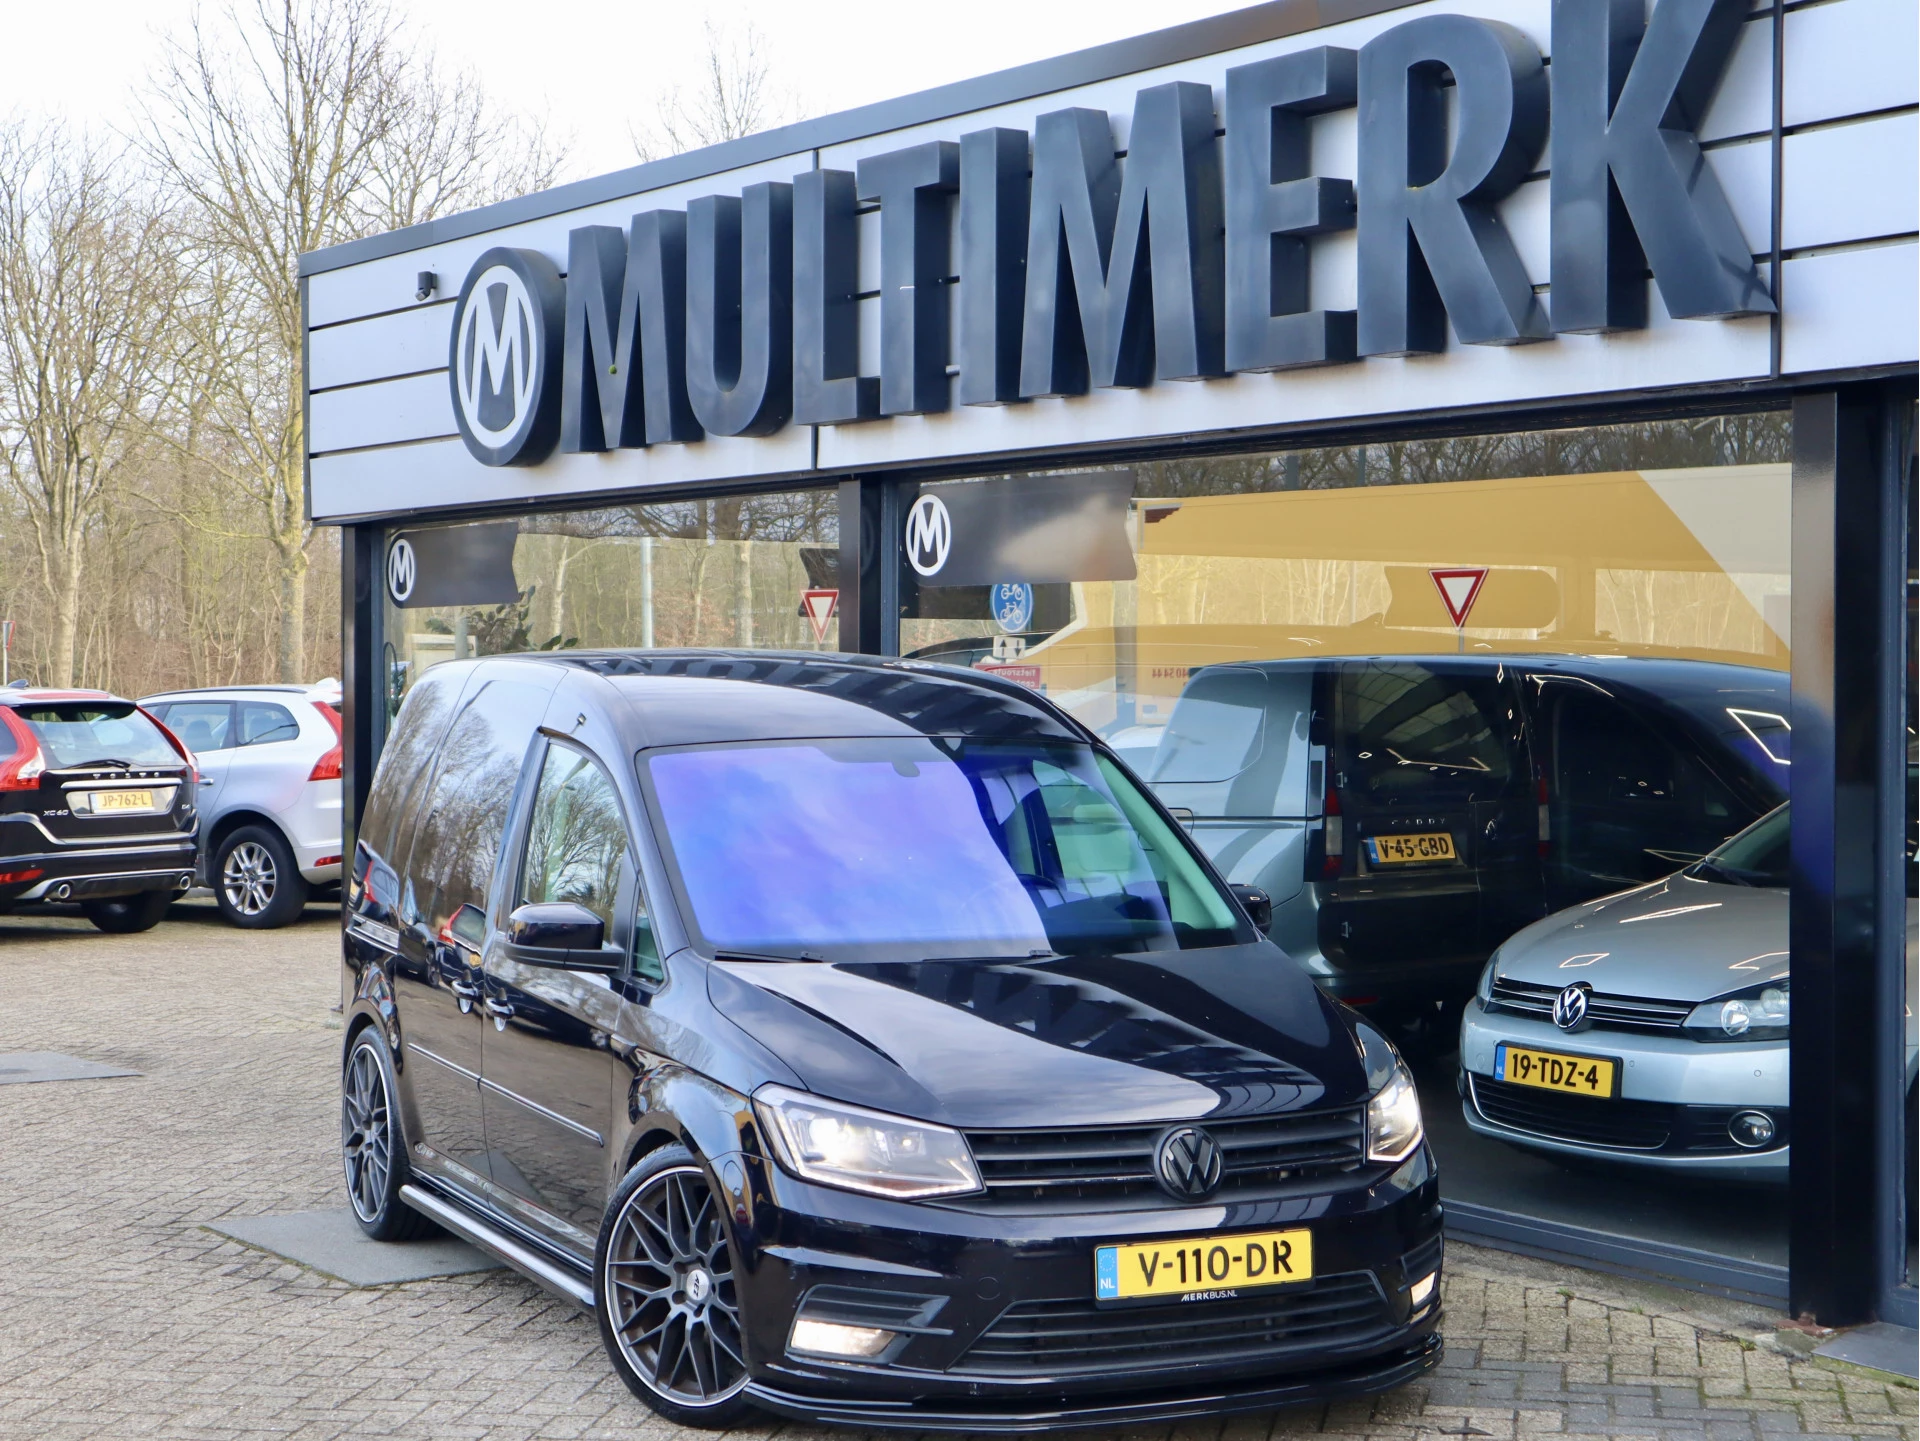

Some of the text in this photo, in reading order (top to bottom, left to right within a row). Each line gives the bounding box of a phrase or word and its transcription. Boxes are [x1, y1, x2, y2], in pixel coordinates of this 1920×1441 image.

[561, 0, 1777, 454] MULTIMERK
[102, 793, 148, 807] JP-762-L
[1380, 837, 1449, 858] V-45-GBD
[1513, 1053, 1598, 1090] 19-TDZ-4
[1138, 1240, 1293, 1287] V-110-DR
[1100, 1278, 1115, 1289] NL
[1181, 1290, 1237, 1302] MERKBUS.NL
